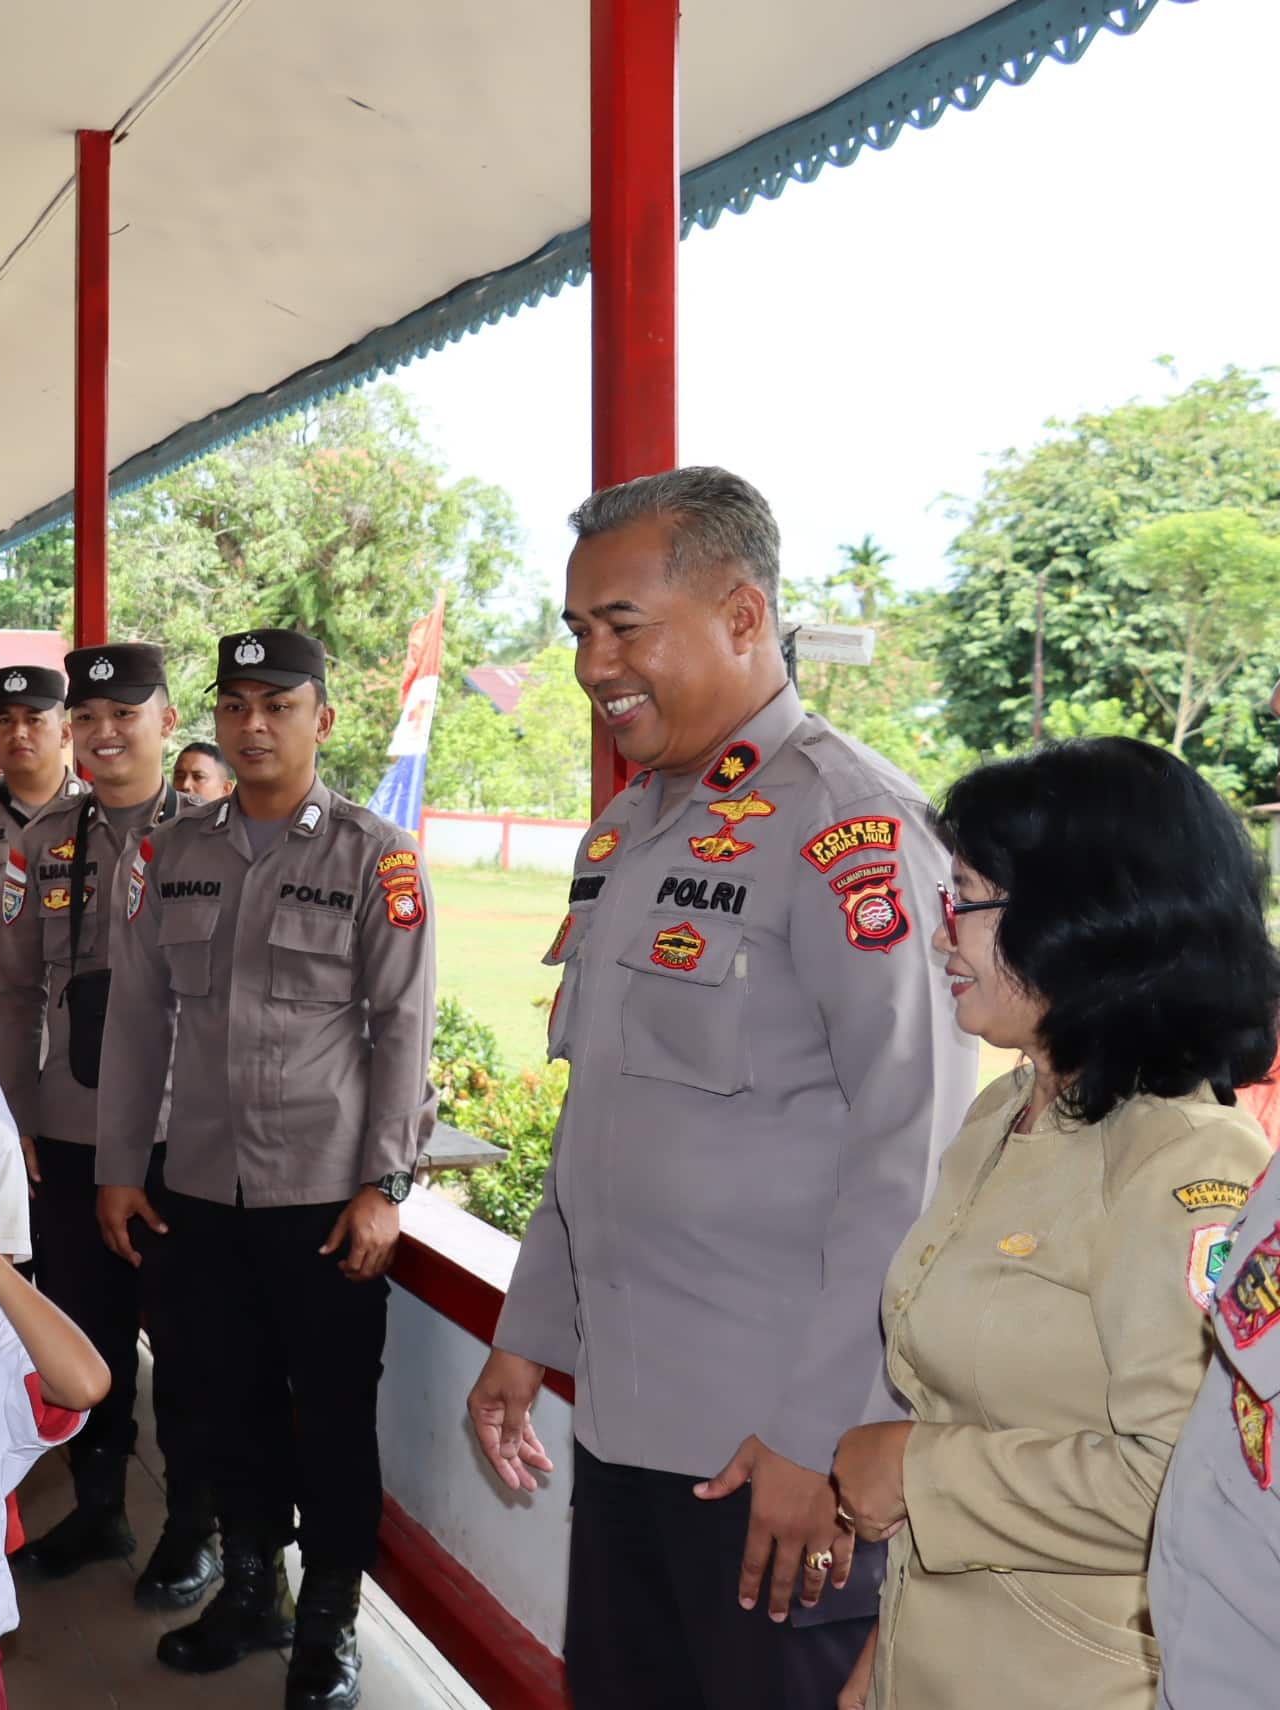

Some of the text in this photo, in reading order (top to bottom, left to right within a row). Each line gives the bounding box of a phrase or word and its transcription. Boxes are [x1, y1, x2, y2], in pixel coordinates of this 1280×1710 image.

[812, 822, 890, 856] POLRES
[817, 832, 891, 865] KAPUAS HULU
[161, 881, 222, 899] MUHADI
[279, 883, 354, 910] POLRI
[656, 876, 747, 915] POLRI
